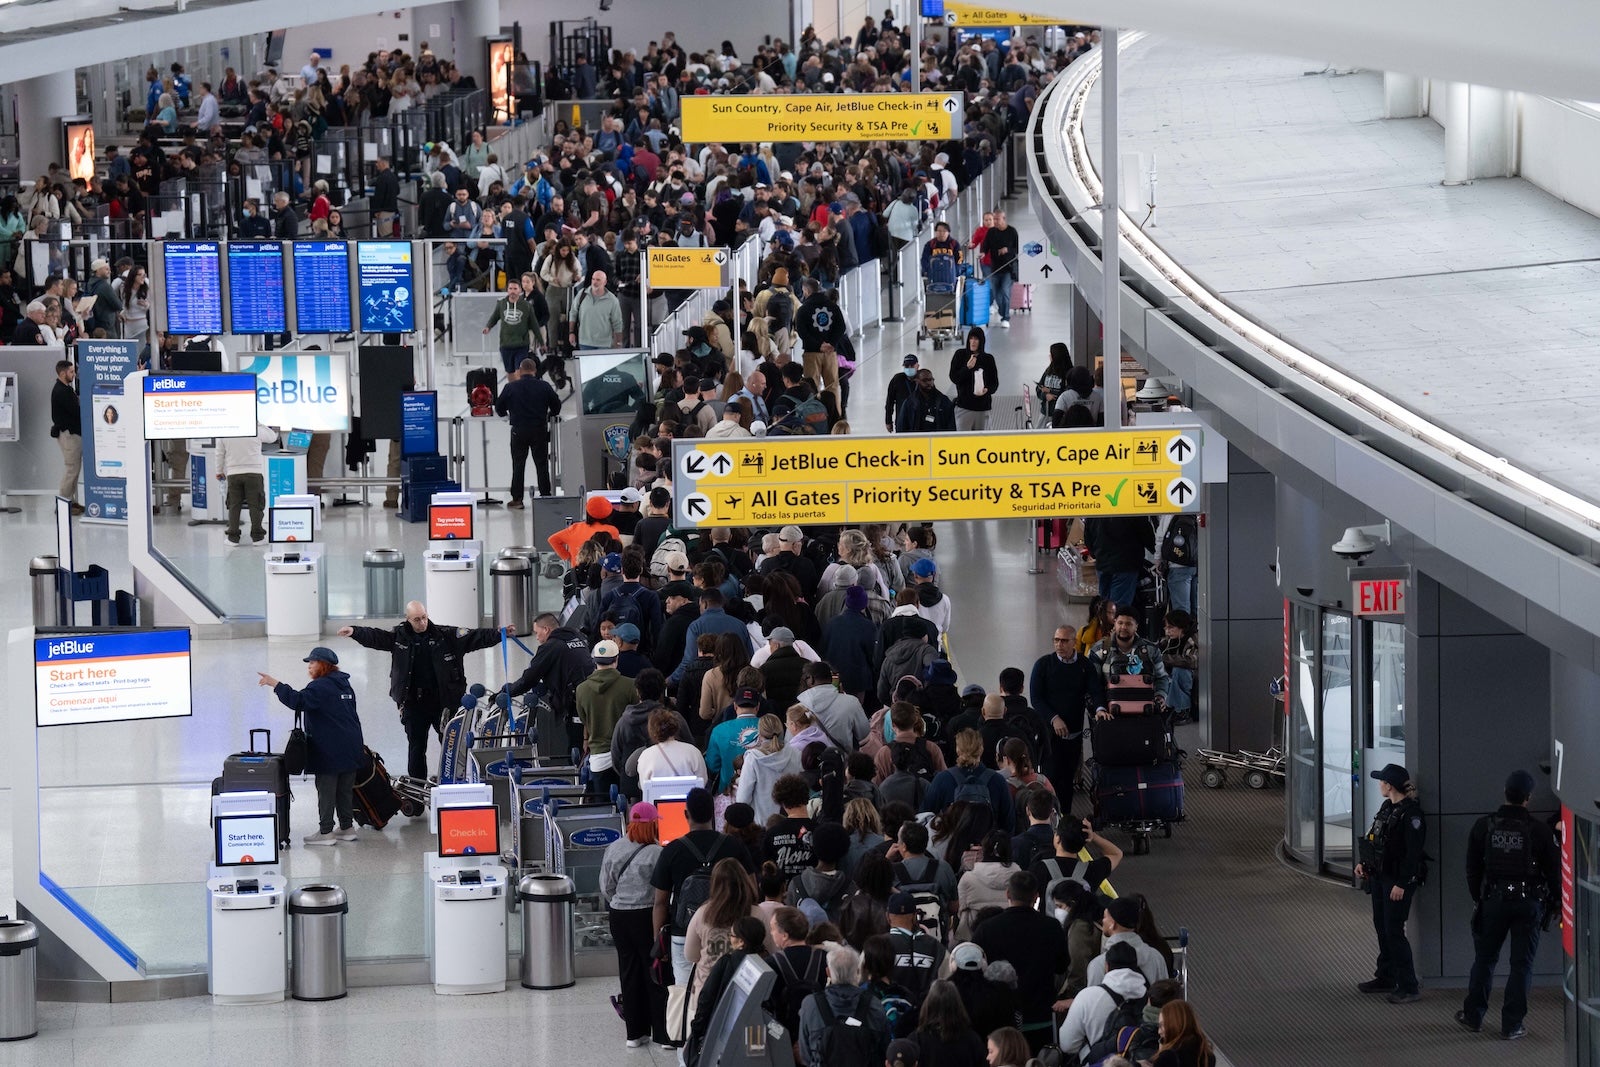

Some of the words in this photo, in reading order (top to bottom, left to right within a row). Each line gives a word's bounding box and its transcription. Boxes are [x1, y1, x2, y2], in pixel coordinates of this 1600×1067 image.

[712, 104, 732, 113] Sun
[736, 104, 782, 114] Country,
[785, 103, 812, 114] Cape
[815, 102, 832, 112] Air,
[836, 102, 874, 111] JetBlue
[878, 101, 923, 111] Check-in
[768, 122, 806, 133] Priority
[810, 122, 852, 133] Security
[856, 122, 864, 131] &
[867, 121, 888, 130] TSA
[891, 122, 908, 130] Pre
[666, 254, 690, 262] Gates
[88, 346, 121, 354] Everything
[152, 379, 186, 391] jetBlue
[257, 380, 337, 404] etBlue
[154, 399, 178, 408] Start
[181, 399, 202, 407] here
[607, 429, 629, 437] POLIC
[771, 452, 838, 470] JetBlue
[845, 450, 924, 468] Check-in
[938, 450, 970, 465] Sun
[976, 447, 1050, 466] Country,
[1057, 446, 1099, 465] Cape
[1105, 443, 1130, 460] Air
[752, 490, 777, 507] All
[784, 490, 840, 506] Gates
[854, 486, 921, 506] Priority
[928, 484, 1003, 504] Security
[1010, 483, 1023, 499] &
[1029, 482, 1065, 498] TSA
[1073, 481, 1101, 496] Pre
[1012, 504, 1055, 513] Seguridad
[793, 511, 826, 520] puertas
[1360, 581, 1399, 612] EXIT
[48, 641, 94, 658] jetBlue
[50, 669, 84, 681] Start
[88, 668, 116, 678] here
[50, 697, 96, 706] Comenzar
[445, 729, 456, 779] smartecarte
[1554, 739, 1564, 791] 7
[450, 828, 476, 837] Check
[478, 828, 488, 836] in.
[1492, 835, 1524, 845] POLICE
